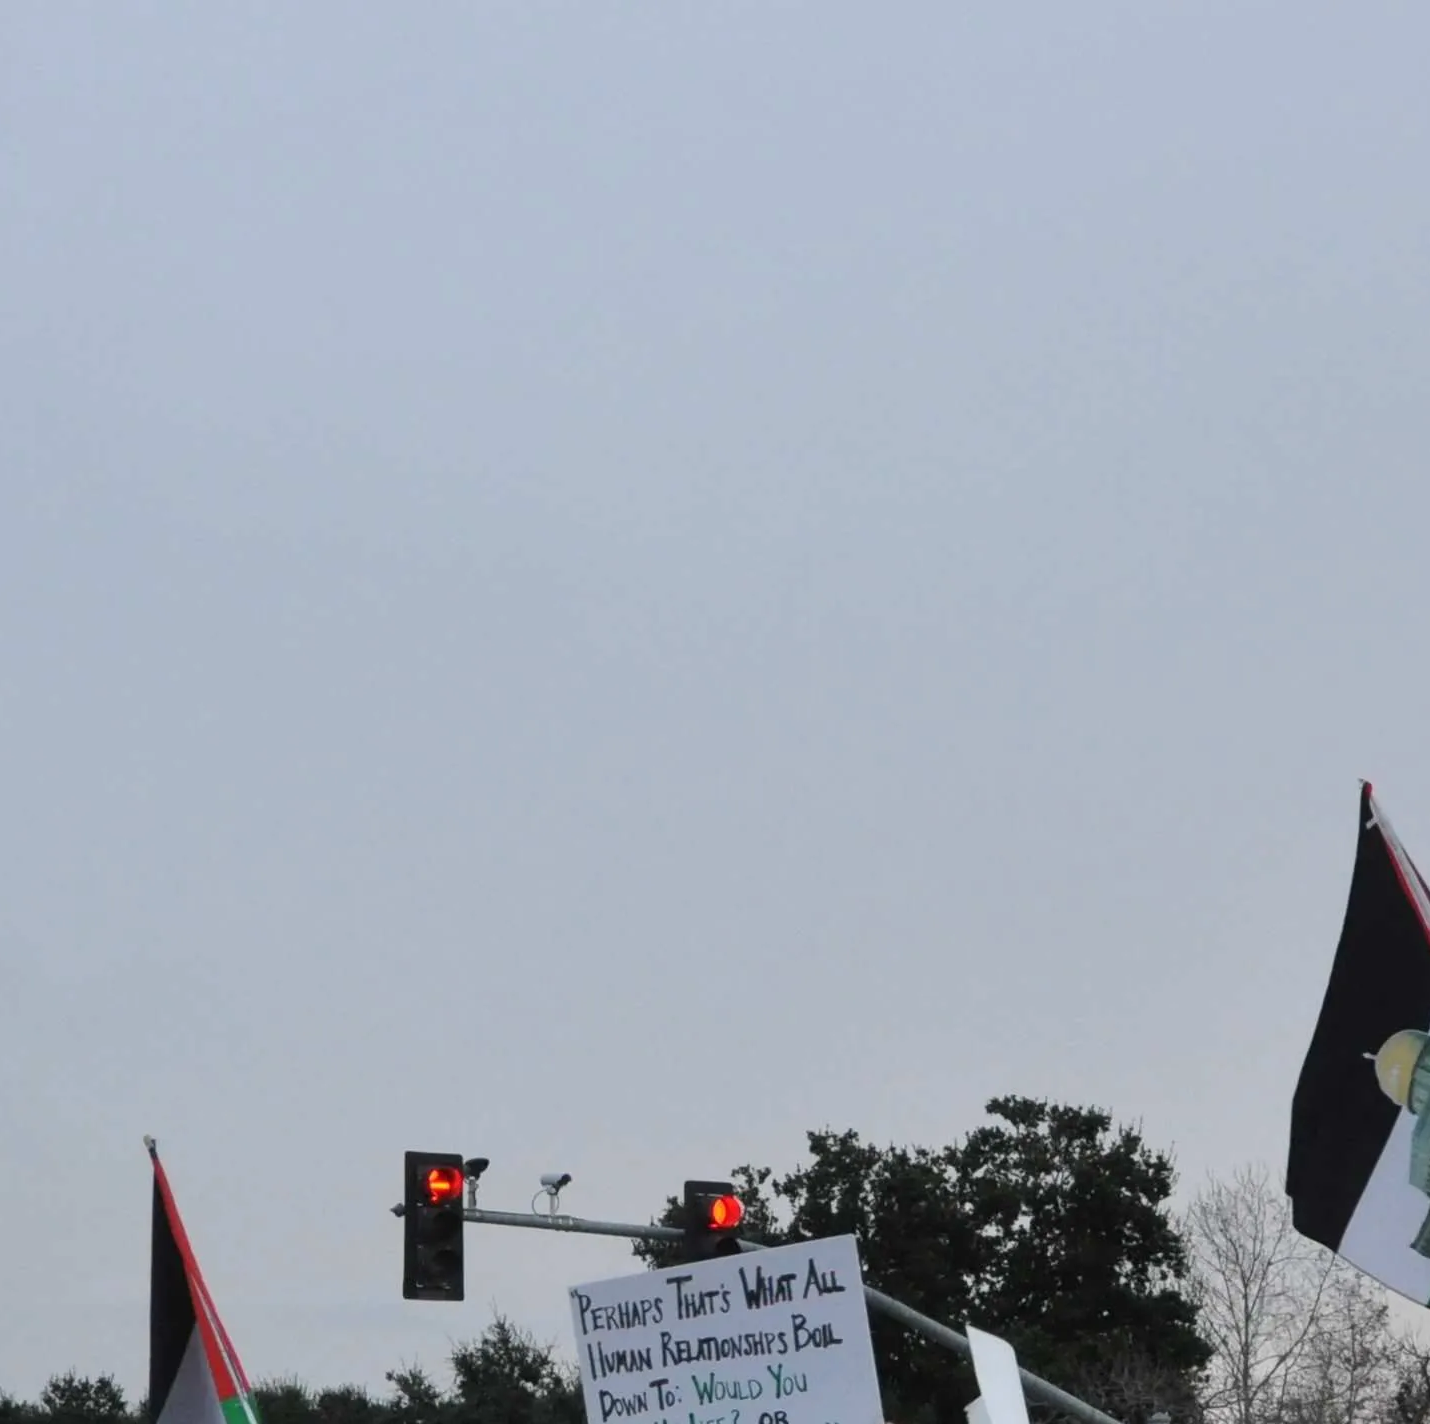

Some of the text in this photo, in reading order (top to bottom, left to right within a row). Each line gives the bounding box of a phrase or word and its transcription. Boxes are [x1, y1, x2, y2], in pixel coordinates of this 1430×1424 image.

[739, 1265, 797, 1310] WHAT
[803, 1258, 846, 1299] ALL
[587, 1341, 653, 1381] HUMAN
[791, 1313, 843, 1352] BOIL
[599, 1363, 808, 1423] DOWN TO: WOULD YOU
